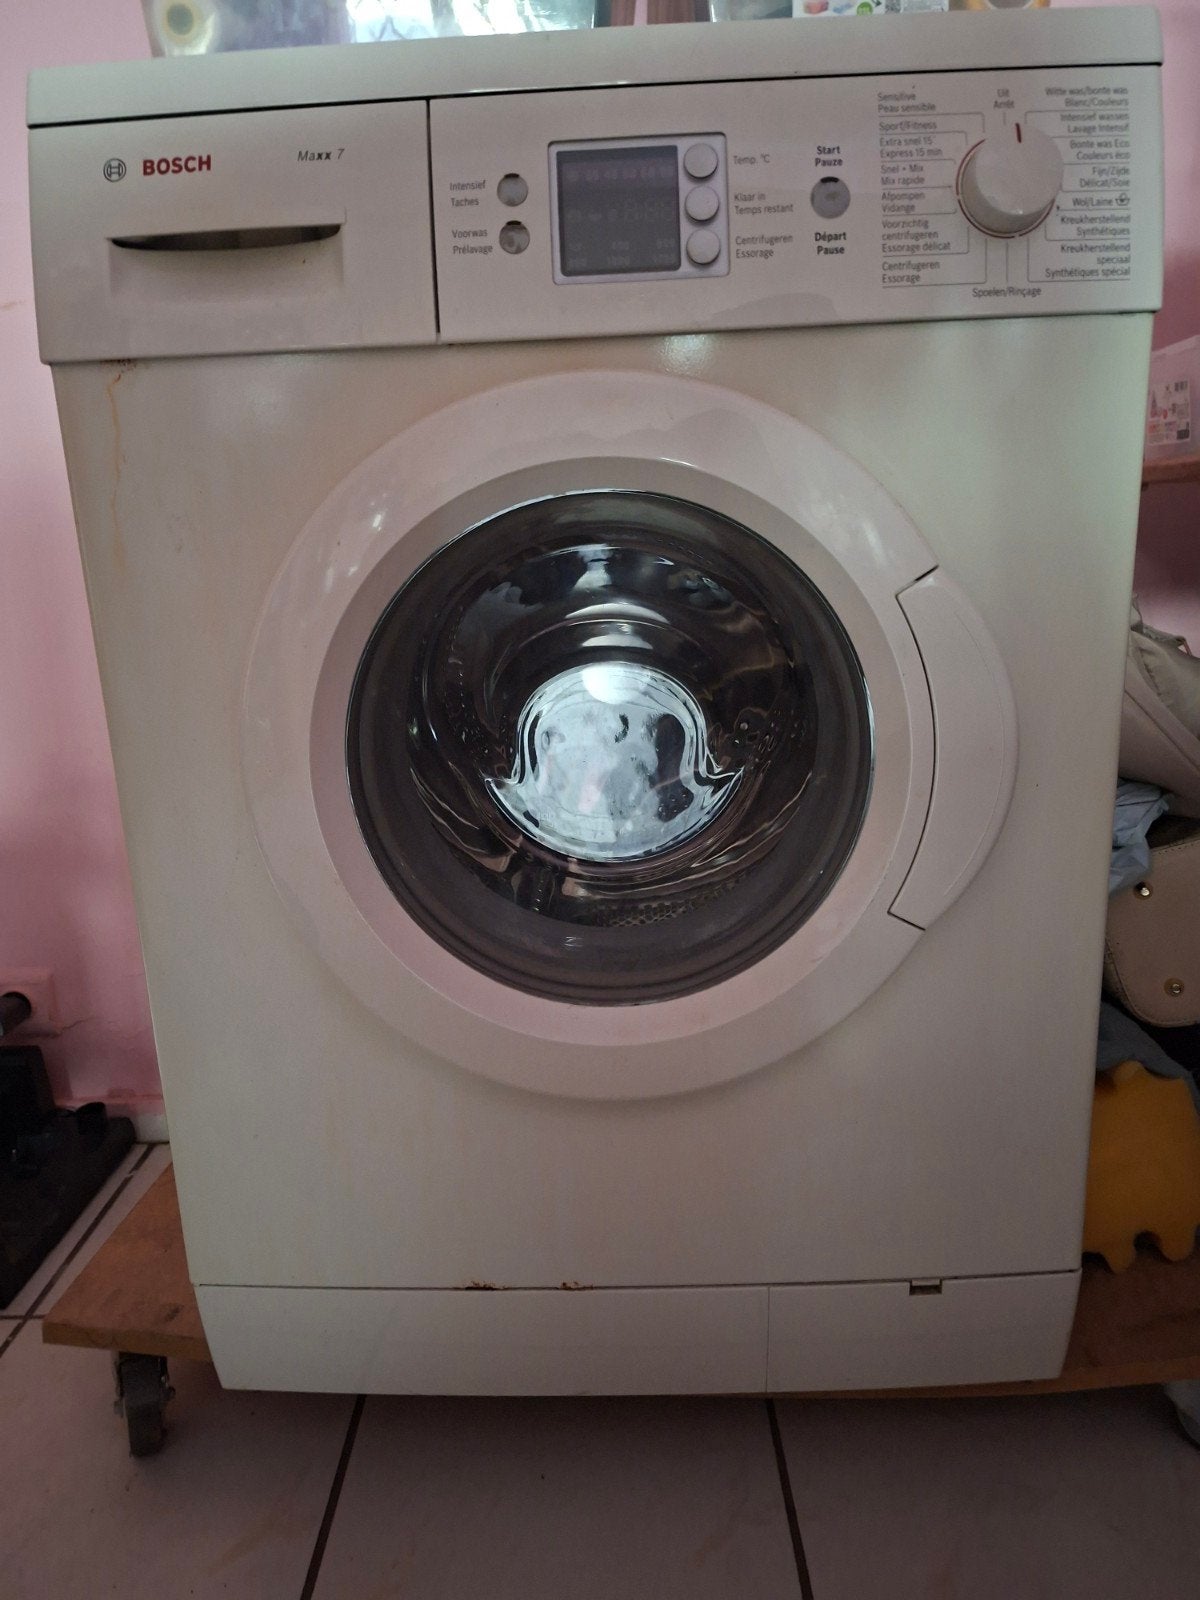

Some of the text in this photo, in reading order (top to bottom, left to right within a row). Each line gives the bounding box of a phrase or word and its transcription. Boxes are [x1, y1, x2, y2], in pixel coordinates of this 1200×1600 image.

[878, 102, 936, 113] Peau sensible
[1068, 124, 1097, 134] Lavage
[879, 138, 903, 147] Extra
[904, 137, 922, 146] snel
[1070, 140, 1093, 149] Bonte
[1115, 139, 1129, 148] Eco
[817, 145, 841, 154] Start
[880, 147, 942, 159] Express 15 min
[297, 149, 345, 162] Maxx 7
[1076, 151, 1113, 160] Couleurs
[143, 154, 211, 176] BOSCH
[815, 157, 843, 167] Pauze
[880, 165, 899, 174] Snel
[908, 164, 923, 173] Mix
[449, 179, 486, 191] Intensief
[881, 175, 925, 185] Mix rapide
[450, 197, 479, 207] Taches
[734, 193, 766, 201] Klaar in
[881, 191, 925, 202] Afpompen
[1073, 197, 1113, 207] Wol/Laine
[735, 204, 794, 215] Temps restant
[882, 203, 915, 214] Vidange
[882, 218, 929, 229] Voorzichtig
[1060, 215, 1130, 225] Kreukherstellend
[452, 228, 488, 238] Voorwas
[882, 230, 938, 241] centrifugeren
[1077, 225, 1130, 237] Synthétiques
[736, 235, 793, 246] Centrifugeren
[815, 232, 847, 243] Départ
[453, 244, 493, 255] Prélavage
[817, 245, 845, 255] Pause
[882, 241, 951, 254] Essorage délicat
[1060, 243, 1130, 253] Kreukherstellend
[736, 248, 774, 259] Essorage
[1097, 254, 1130, 265] speciaal
[882, 260, 940, 271] Centrifugeren
[882, 272, 921, 284] Essorage
[1045, 266, 1130, 279] Synthétiques spécial
[972, 286, 1041, 298] Spoelen/Rinçage
